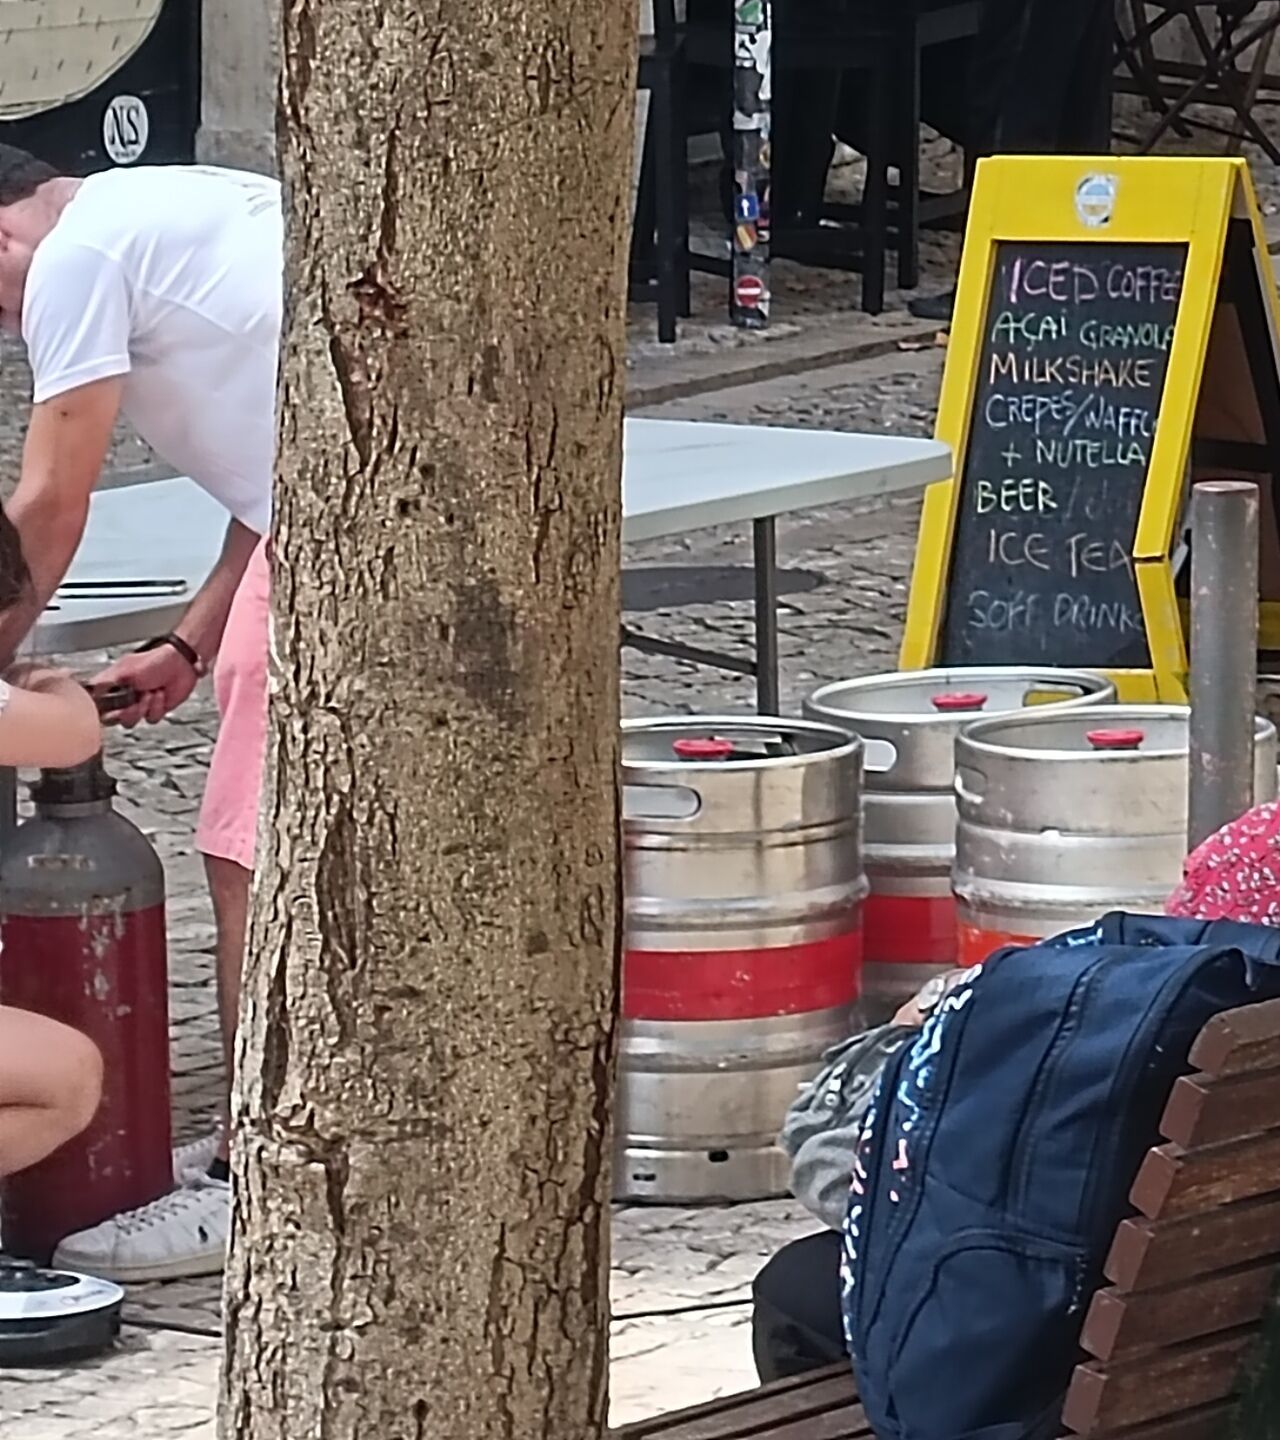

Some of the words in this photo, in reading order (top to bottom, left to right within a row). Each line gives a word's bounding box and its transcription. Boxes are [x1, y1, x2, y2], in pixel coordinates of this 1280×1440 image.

[1010, 258, 1099, 304] ICED
[1107, 264, 1181, 303] COFFE
[985, 389, 1157, 438] CREPES/WAFFL
[1036, 438, 1146, 469] NUTELLA
[977, 478, 1058, 513] BEER
[989, 528, 1050, 571] ICE
[1066, 532, 1134, 583] TEA
